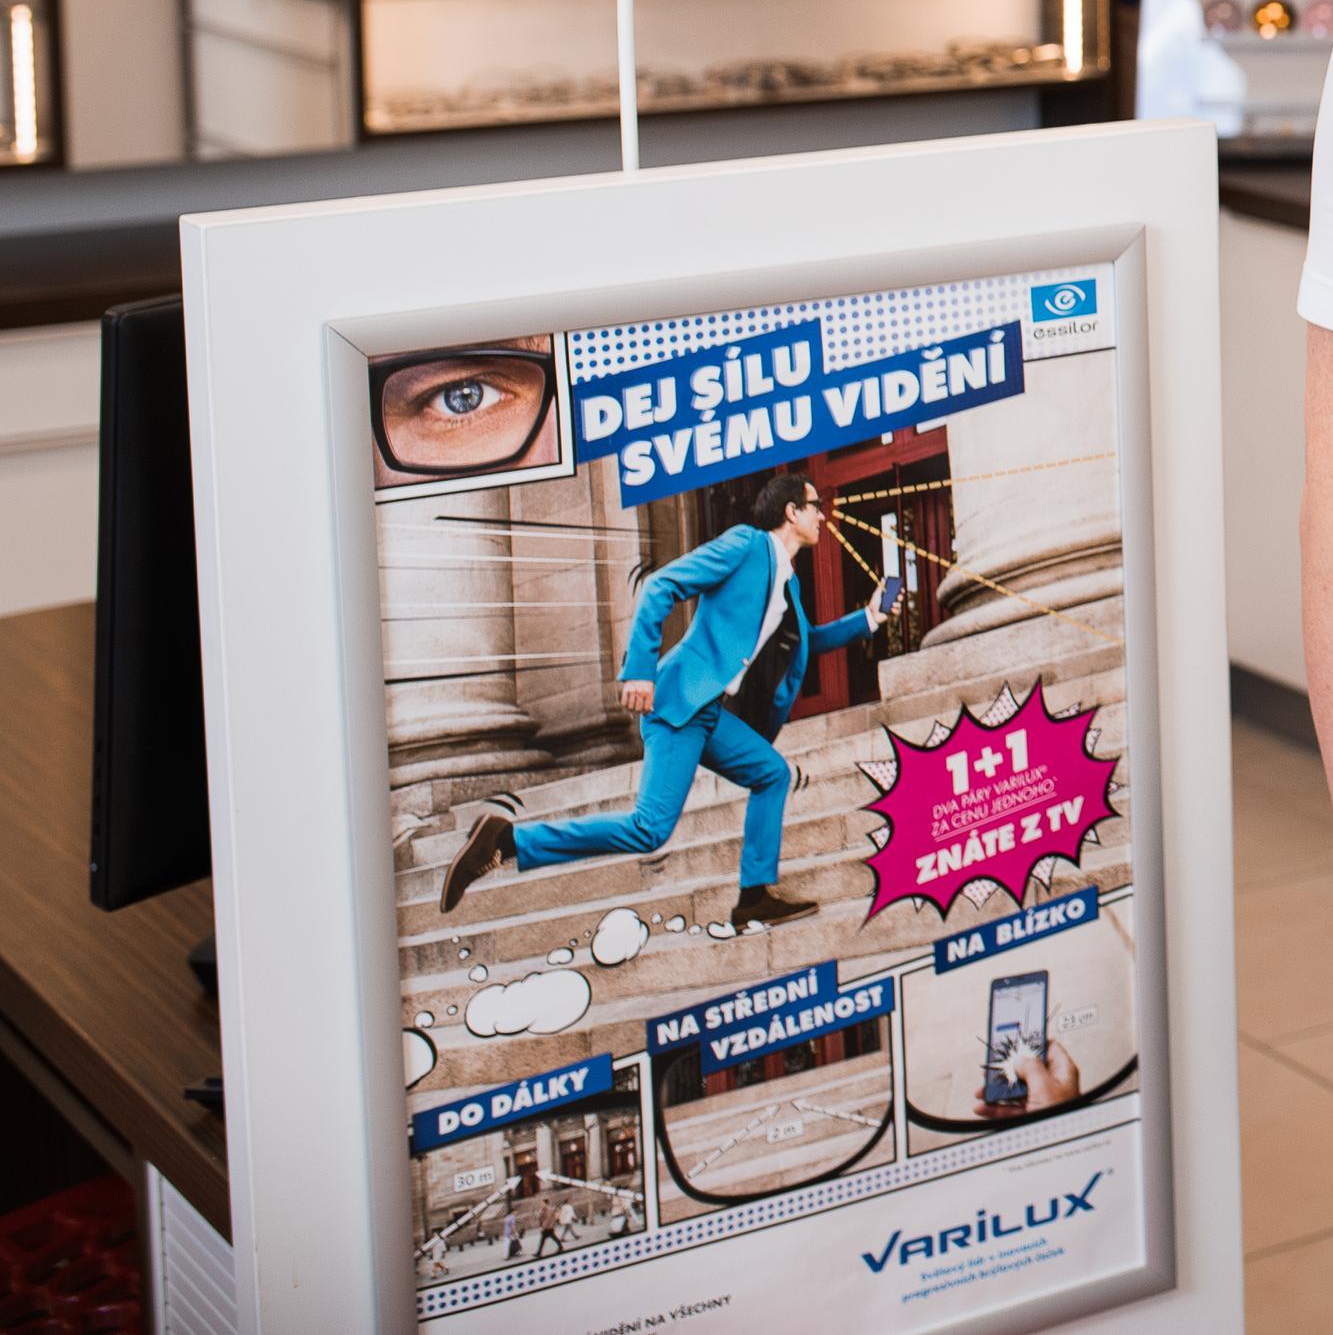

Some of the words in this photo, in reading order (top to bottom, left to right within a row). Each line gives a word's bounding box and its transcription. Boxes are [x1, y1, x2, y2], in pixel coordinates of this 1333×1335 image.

[1033, 320, 1098, 340] essilor
[581, 377, 677, 443] DEJ
[690, 340, 811, 410] SÍLU
[621, 395, 812, 487] SVÉMU
[822, 329, 1006, 428] VIDĚNÍ
[946, 728, 1029, 796] 1+1
[915, 829, 1016, 886] ZNÁTE
[1020, 813, 1043, 844] Z
[1046, 796, 1084, 833] TV
[931, 819, 950, 837] ZA
[951, 803, 989, 828] CENU
[932, 799, 959, 820] DVA
[947, 932, 986, 963] NA
[996, 897, 1086, 945] BLÍZKO
[656, 1014, 700, 1046] NA
[705, 968, 818, 1029] STŘEDNÍ
[710, 984, 884, 1061] VZDÁLENOST
[437, 1102, 485, 1135] DO
[491, 1066, 589, 1118] DÁLKY
[456, 1173, 474, 1188] 30
[594, 1316, 642, 1335] IDĚNÍ
[645, 1314, 666, 1329] NA
[668, 1294, 732, 1321] VŠECHNY
